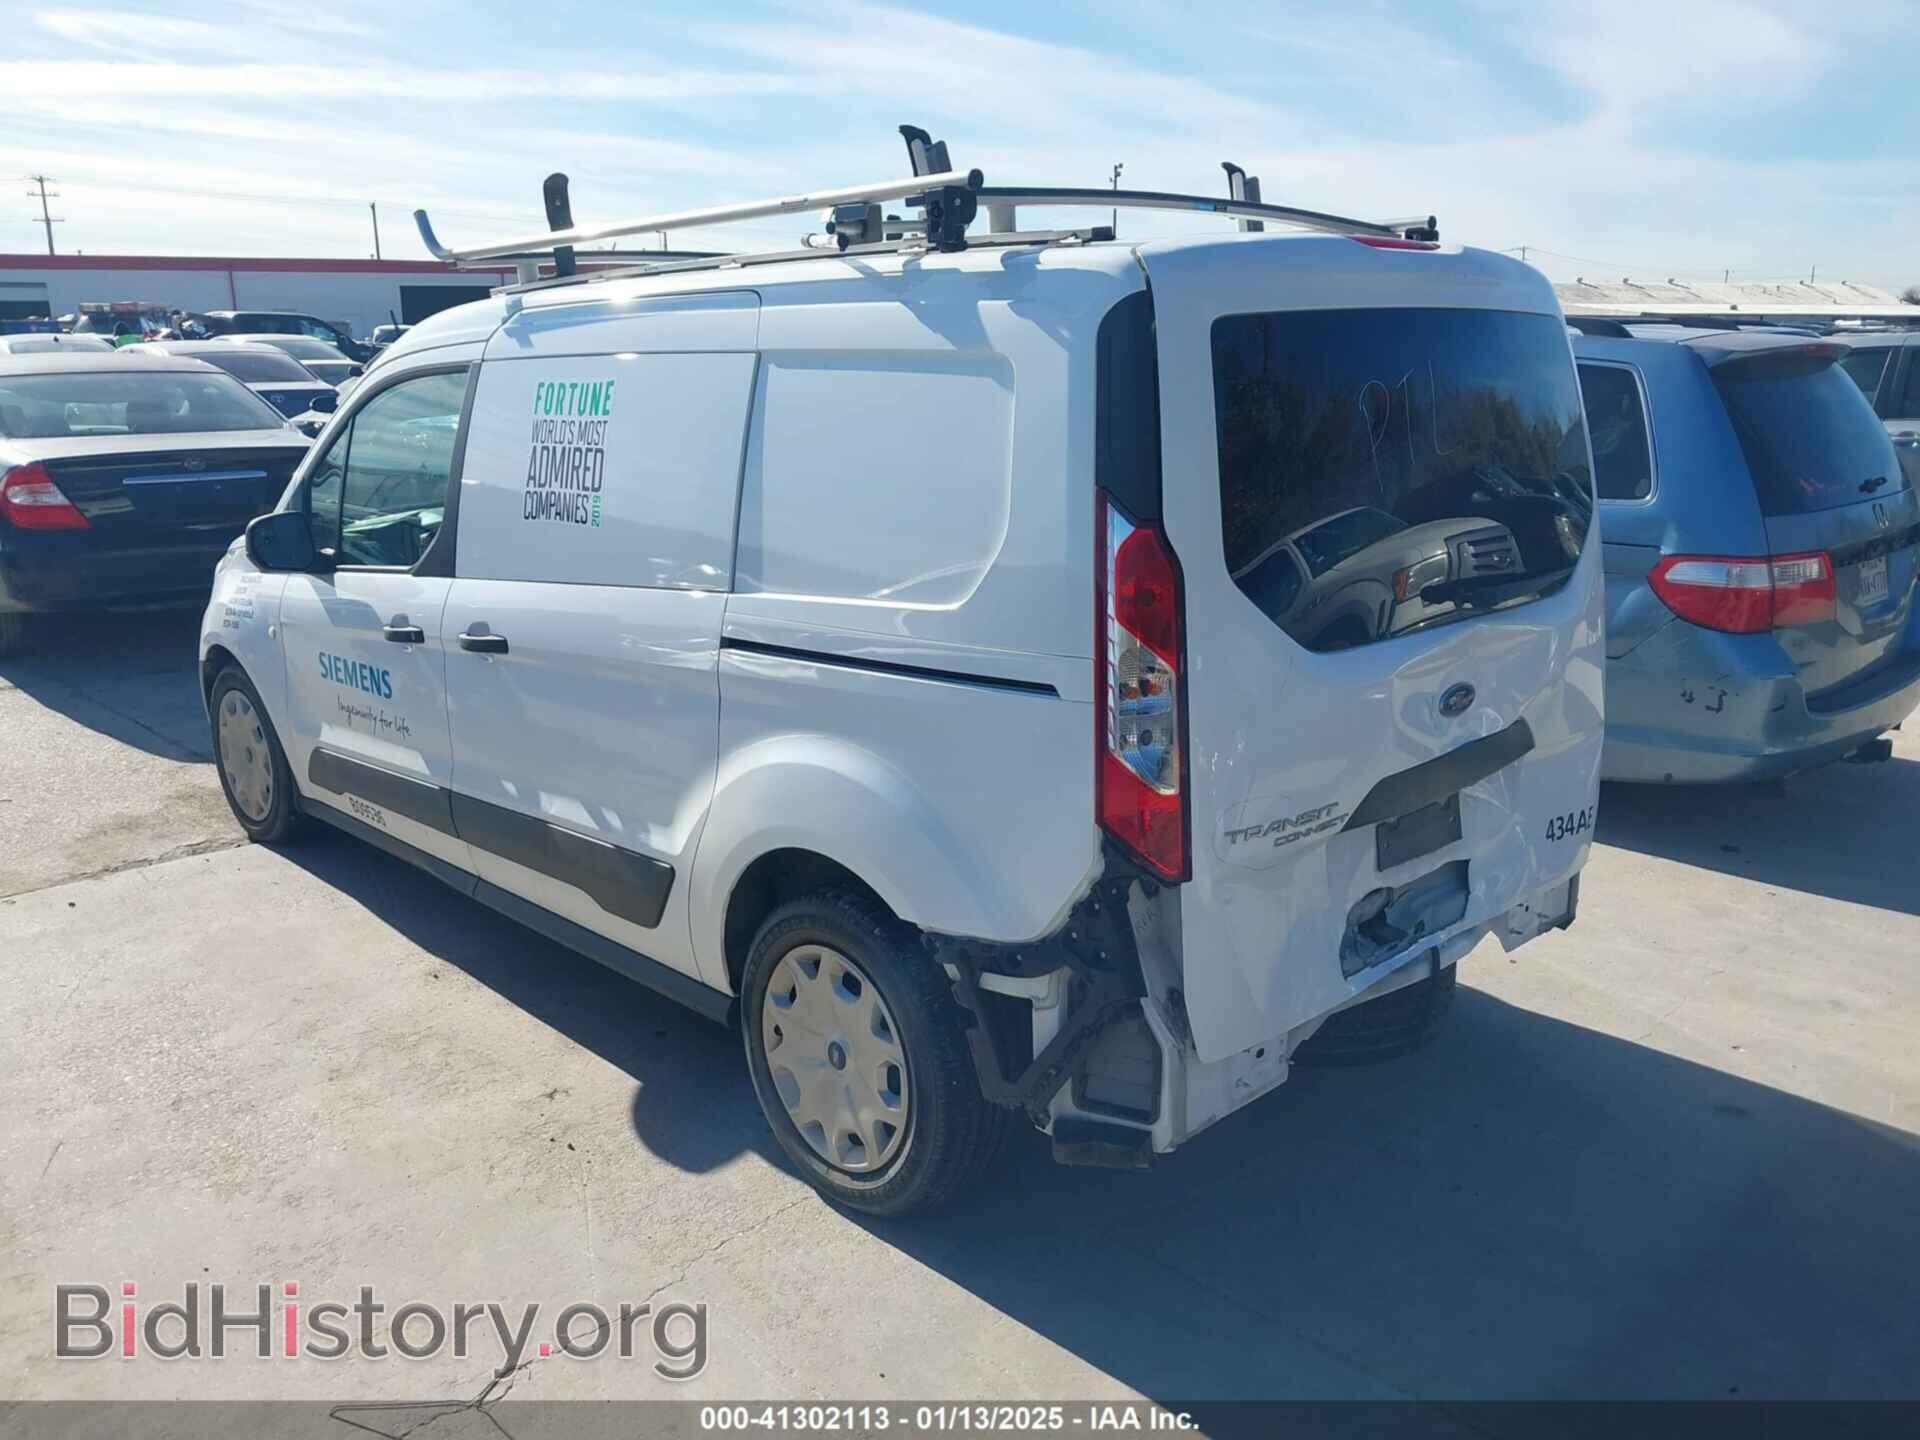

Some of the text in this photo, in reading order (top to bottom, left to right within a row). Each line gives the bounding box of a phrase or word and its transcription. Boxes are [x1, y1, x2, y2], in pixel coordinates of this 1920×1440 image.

[534, 379, 615, 416] FORTUNE
[531, 419, 609, 446] WORLD'S MOST
[526, 446, 605, 493] ADMIRED
[523, 490, 589, 525] COMPANIES
[319, 651, 393, 700] SIEMENS
[336, 693, 378, 737] Ingenuity
[378, 709, 393, 731] for
[1223, 801, 1339, 845] TRANSIT
[1272, 812, 1350, 848] CONNECT
